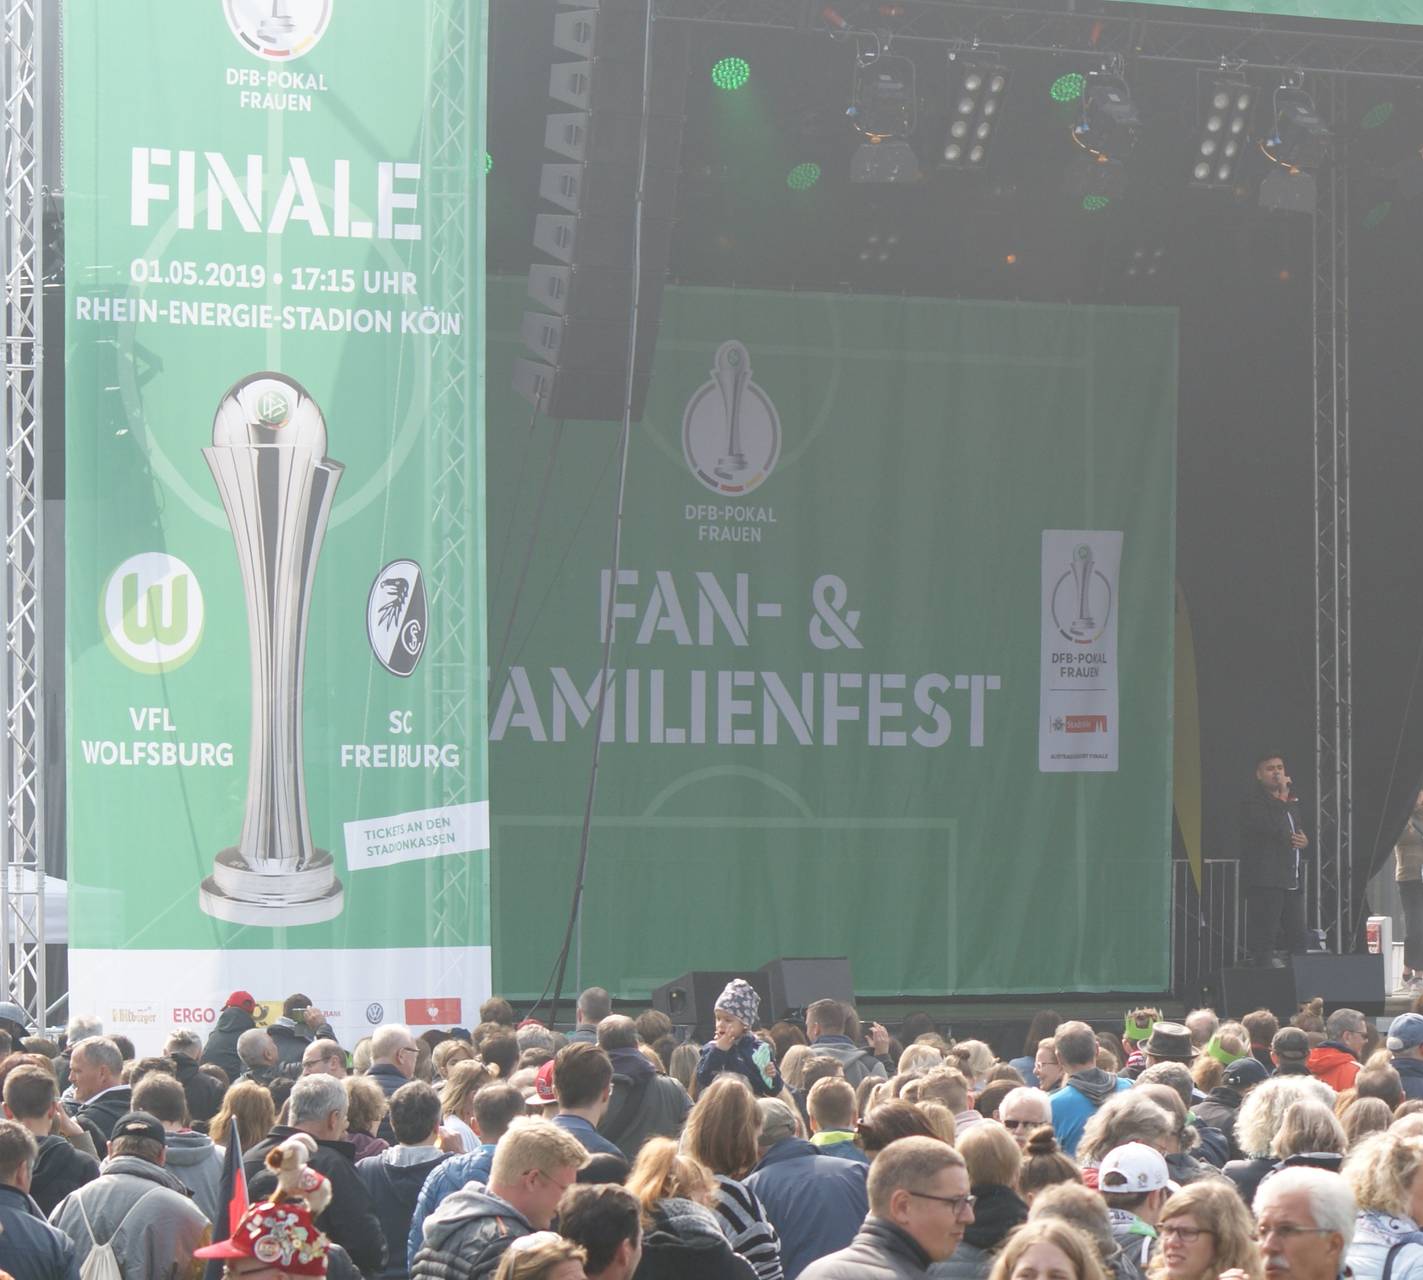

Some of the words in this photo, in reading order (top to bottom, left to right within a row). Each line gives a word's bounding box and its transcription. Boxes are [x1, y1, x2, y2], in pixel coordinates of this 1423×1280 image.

[226, 68, 327, 91] DFB-POKAL
[240, 92, 311, 111] FRAUEN
[131, 147, 421, 240] FINALE
[130, 258, 266, 289] 01.05.2019
[291, 267, 355, 293] 17:15
[363, 270, 418, 295] UHR
[76, 296, 392, 333] RHEIN-ENERGIE-STADION
[401, 306, 461, 335] KÖLN
[685, 505, 777, 523] DFB-POKAL
[699, 525, 762, 543] FRAUEN
[600, 568, 782, 647] FAN-
[809, 574, 864, 650] &
[1052, 653, 1108, 665] DFB-POKAL
[1060, 666, 1099, 678] FRAUEN
[129, 707, 176, 731] VFL
[488, 666, 1000, 748] AMILIENFEST
[389, 710, 413, 734] SC
[81, 740, 234, 767] WOLFSBURG
[341, 744, 460, 768] FREIBURG
[364, 824, 405, 840] TICKETS
[407, 821, 423, 833] AN
[426, 817, 451, 831] DEN
[366, 832, 456, 857] STADIONKASSEN
[173, 1007, 216, 1023] ERGO
